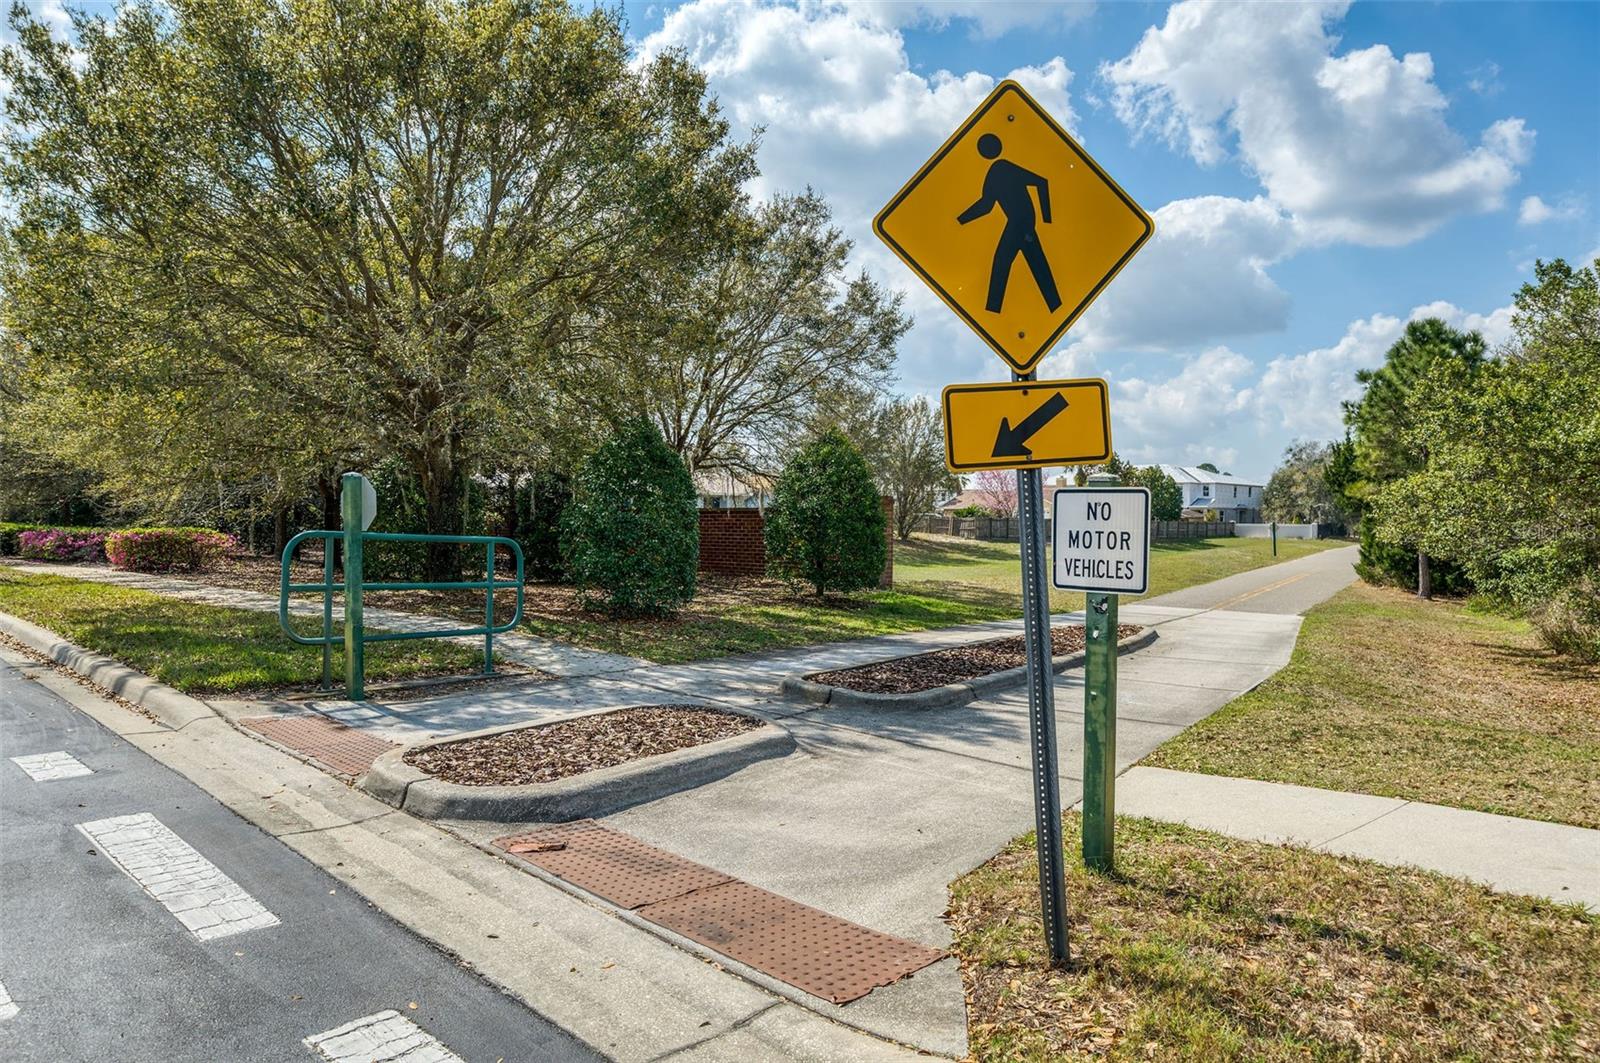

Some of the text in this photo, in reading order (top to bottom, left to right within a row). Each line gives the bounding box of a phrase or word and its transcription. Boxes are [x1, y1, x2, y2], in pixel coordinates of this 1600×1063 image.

[1087, 502, 1111, 521] NO
[1069, 530, 1131, 550] MOTOR
[1065, 558, 1134, 580] VEHICLES
